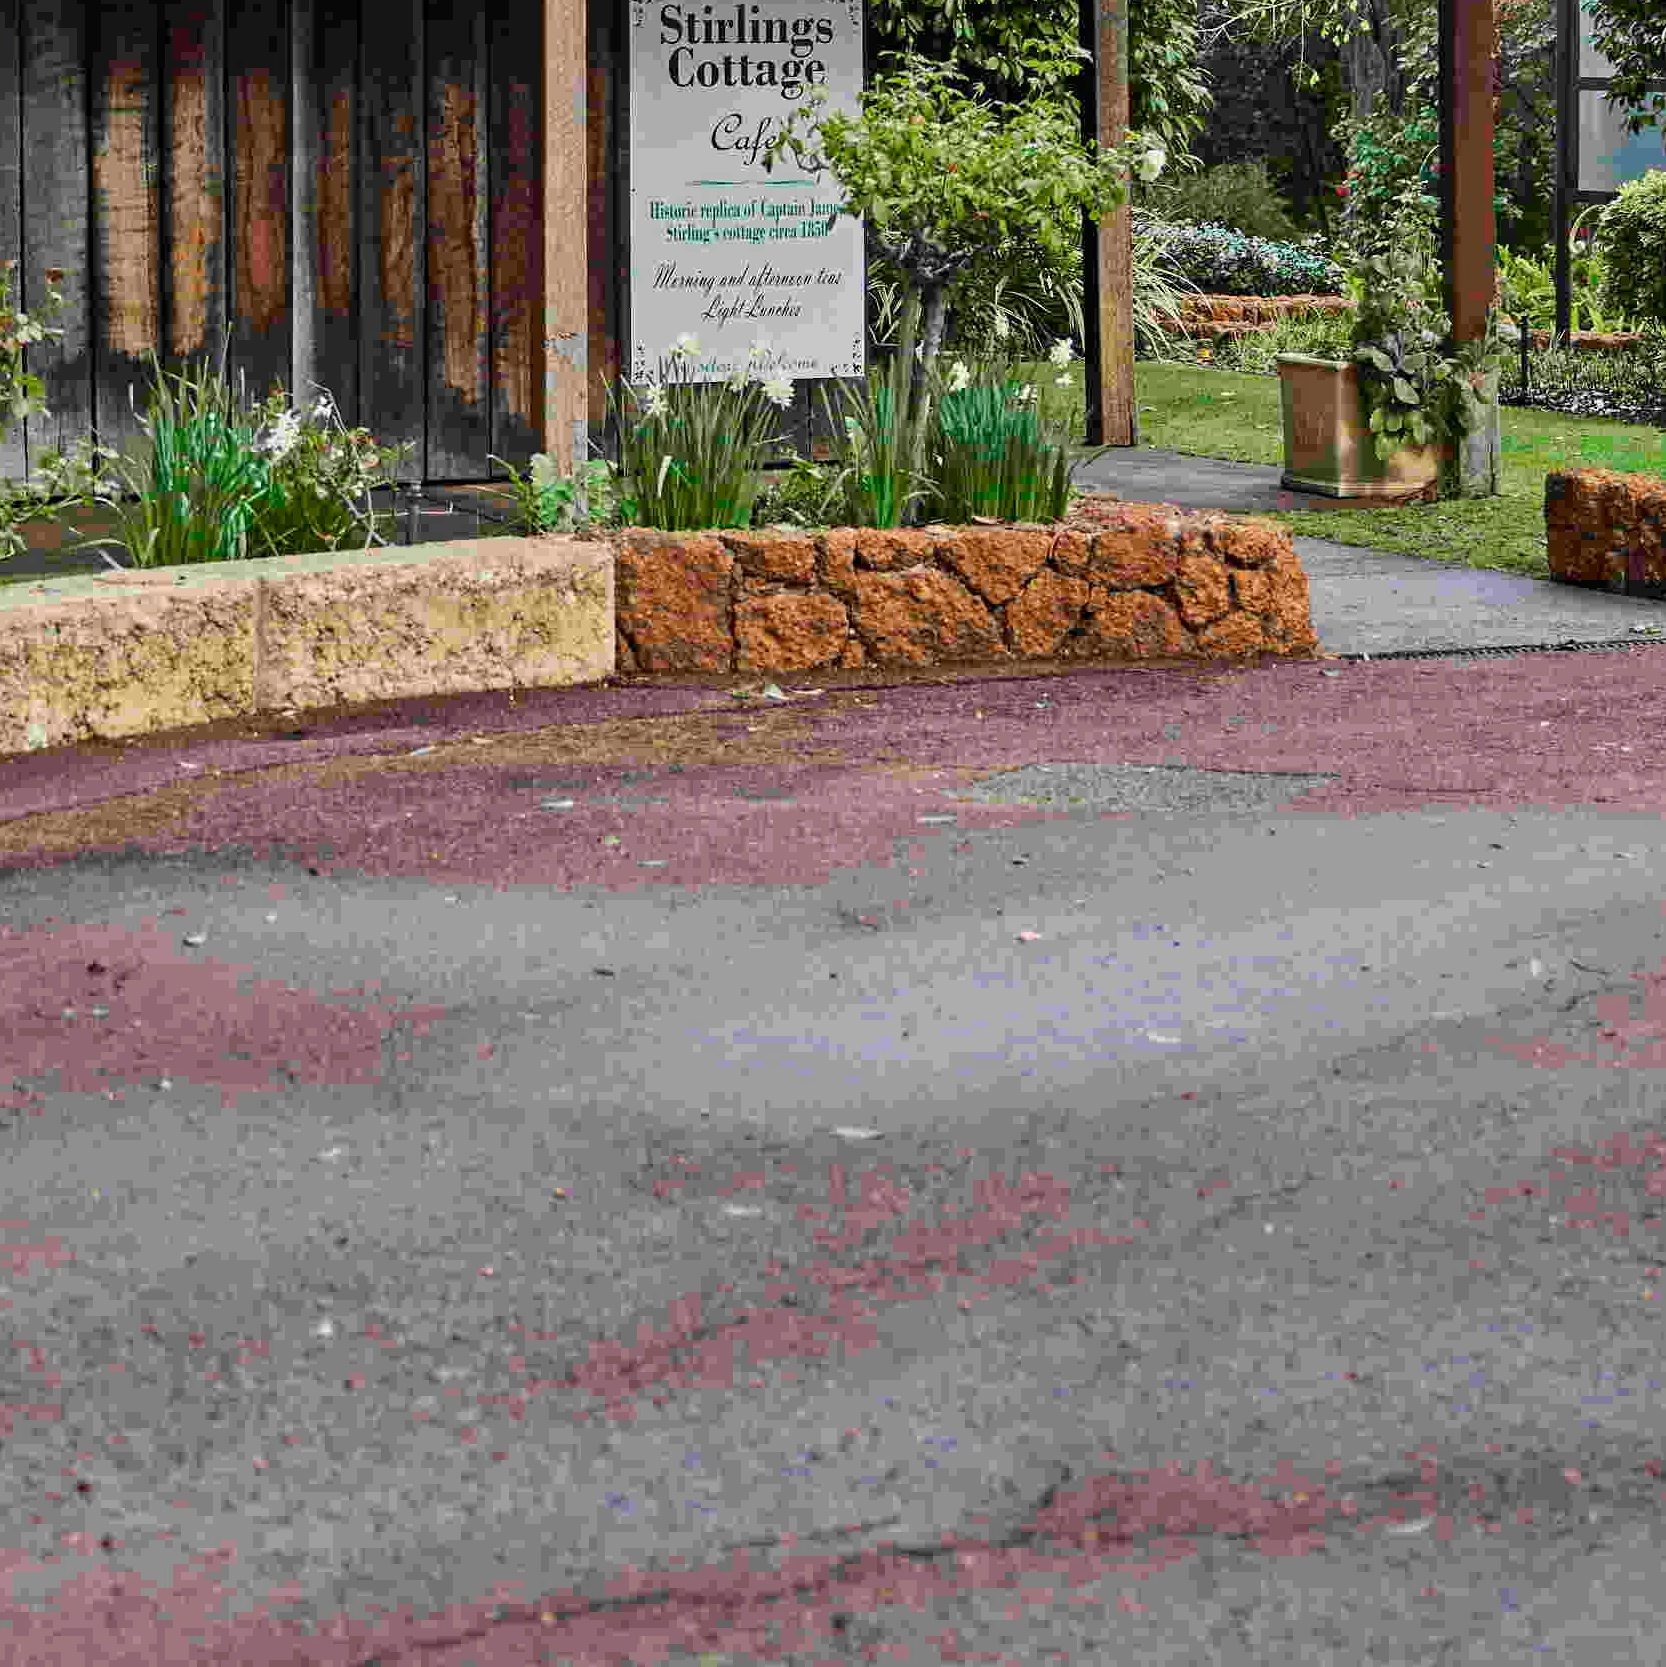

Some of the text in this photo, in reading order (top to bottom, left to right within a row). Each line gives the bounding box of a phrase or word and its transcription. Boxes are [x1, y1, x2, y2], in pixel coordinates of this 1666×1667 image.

[660, 3, 833, 58] Stirlings
[668, 46, 825, 100] Cottage
[650, 199, 694, 220] Historic
[700, 198, 740, 228] replica
[742, 199, 757, 218] of
[760, 198, 804, 226] Captain
[722, 224, 765, 244] cottage
[767, 222, 797, 240] circa
[653, 260, 842, 298] Morning and afternoon teas
[702, 292, 803, 332] Light Lunches
